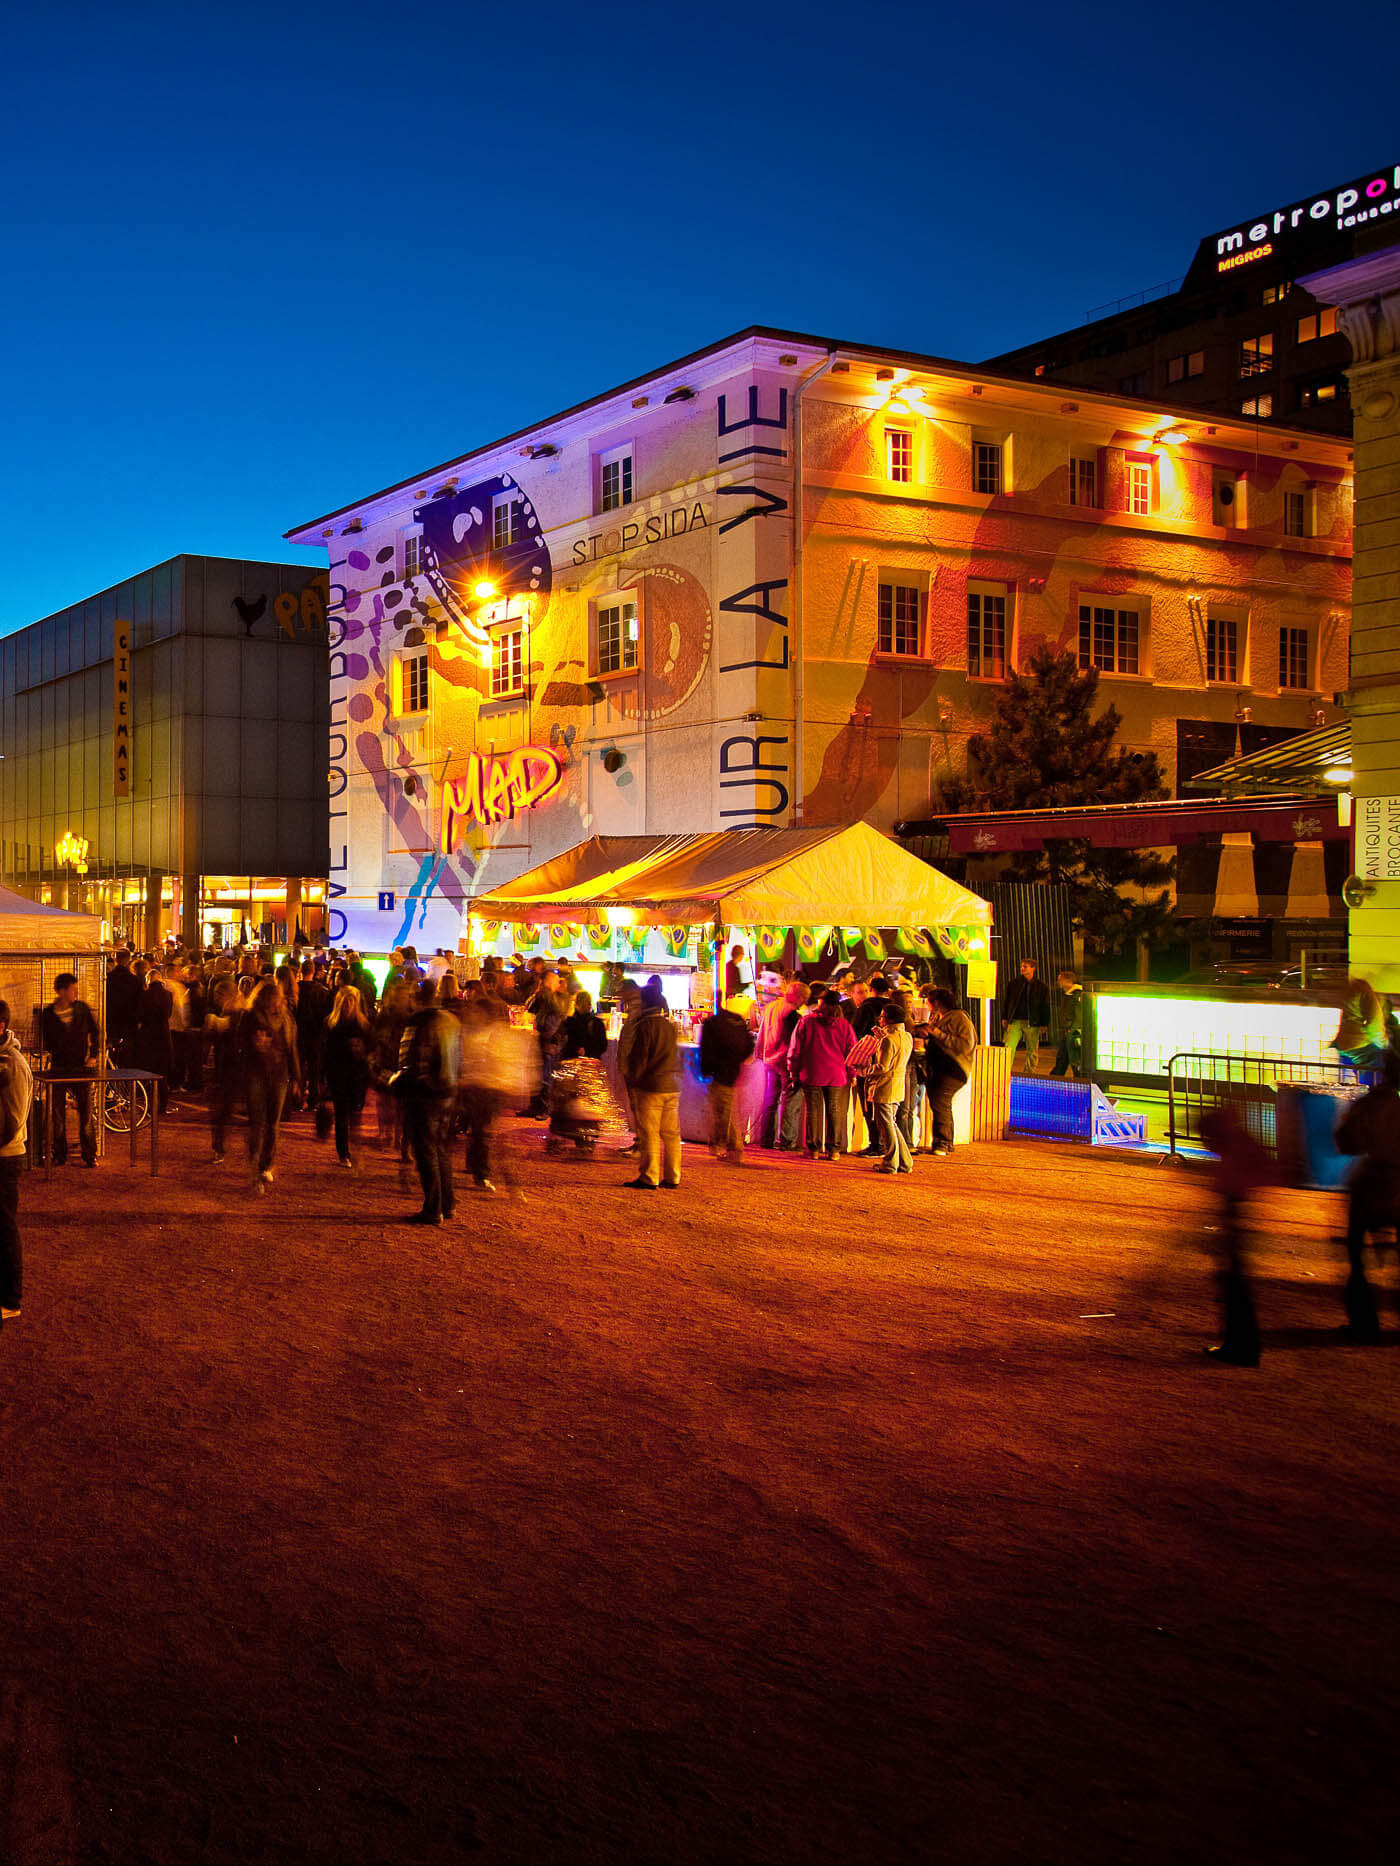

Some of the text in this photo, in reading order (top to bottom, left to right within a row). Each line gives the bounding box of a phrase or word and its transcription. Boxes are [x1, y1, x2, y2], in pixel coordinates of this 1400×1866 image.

[1218, 244, 1273, 272] MIGROS
[716, 384, 788, 536] VIE
[572, 502, 708, 566] STOP SIDA
[719, 578, 788, 673] LA
[117, 635, 128, 782] CINEMAS
[441, 746, 562, 854] MAD
[1365, 799, 1381, 878] ANTIQUITES
[1387, 799, 1400, 877] BROCANTE
